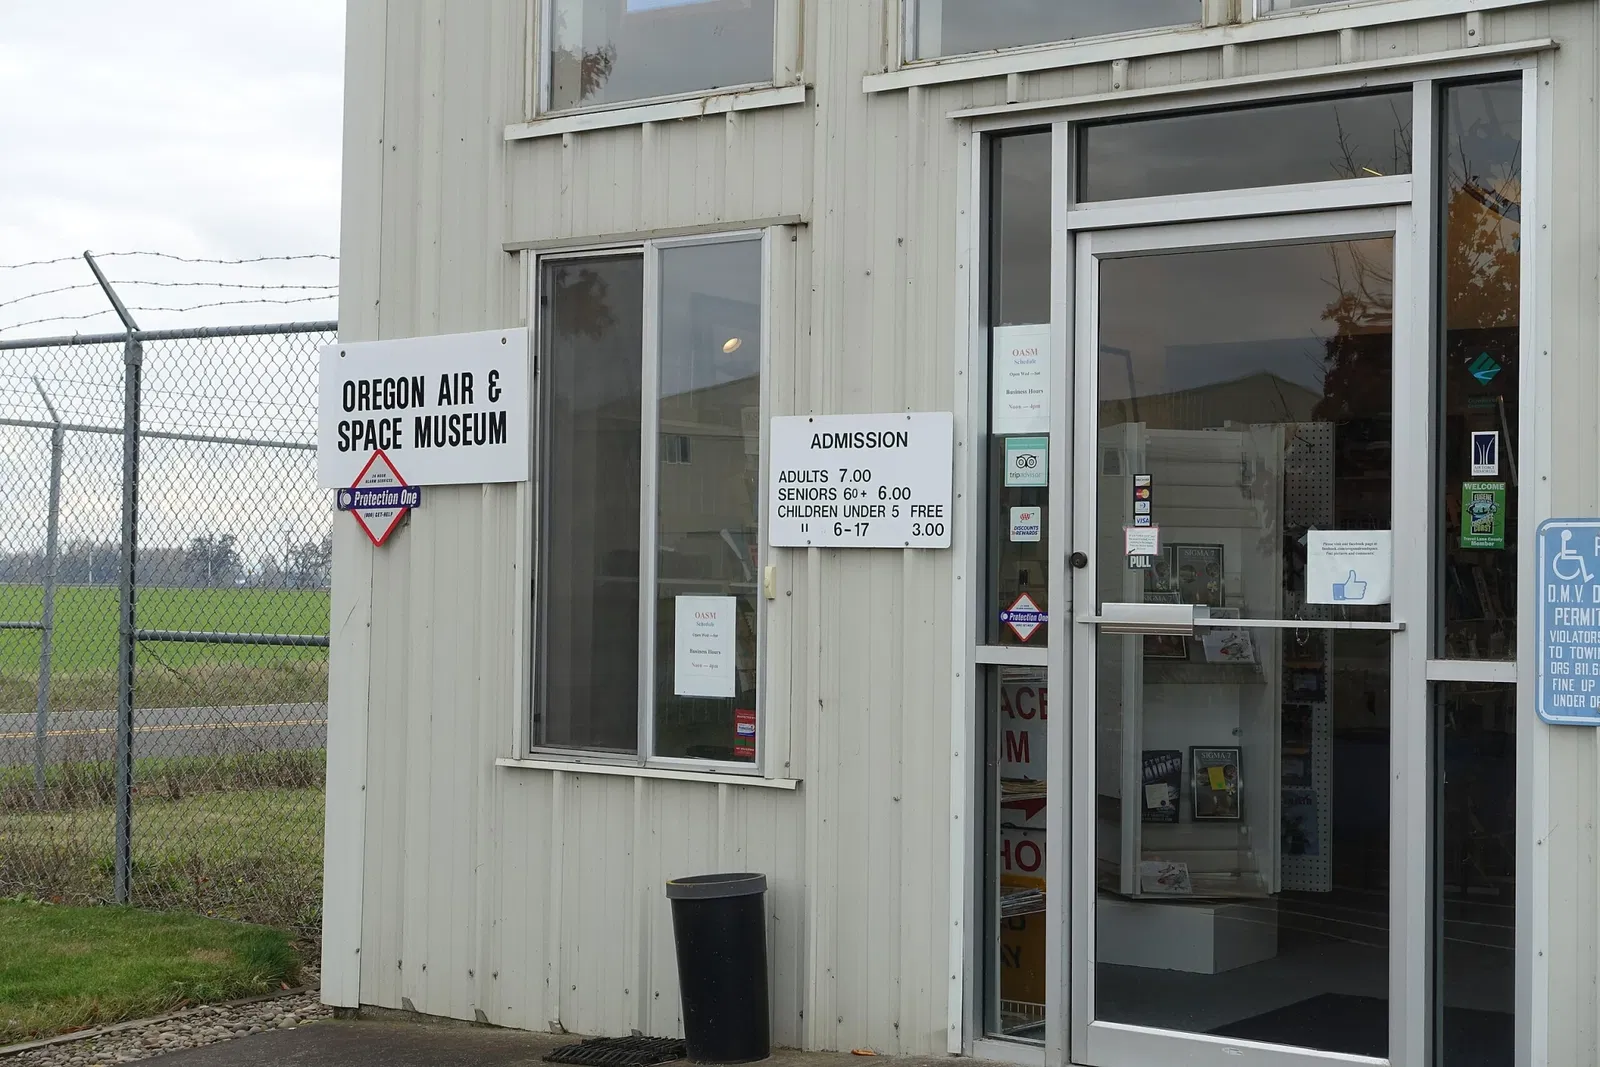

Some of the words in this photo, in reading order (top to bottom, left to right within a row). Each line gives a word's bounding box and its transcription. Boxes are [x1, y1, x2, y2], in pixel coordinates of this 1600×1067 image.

[1012, 348, 1038, 357] OASM
[342, 375, 425, 412] OREGON
[438, 371, 473, 406] AIR
[488, 369, 502, 403] &
[338, 417, 403, 452] SPACE
[414, 410, 507, 448] MUSEUM
[810, 431, 908, 449] ADMISSION
[778, 470, 829, 483] ADULTS
[839, 468, 872, 483] 7.00
[354, 490, 399, 506] Protection
[400, 489, 418, 505] One
[778, 487, 837, 500] SENIORS
[878, 486, 911, 500] 6.00
[777, 504, 838, 518] CHILDREN
[843, 504, 886, 518] UNDER
[891, 504, 900, 518] 5
[910, 504, 943, 518] FREE
[833, 522, 869, 537] 6-17
[912, 522, 945, 536] 3.00
[1130, 555, 1151, 568] PULL
[1548, 584, 1584, 603] D.M.V.
[1009, 613, 1037, 621] Protection
[1549, 646, 1562, 659] TO
[1551, 662, 1569, 675] ORS
[1575, 663, 1600, 676] 811.6
[1552, 678, 1574, 692] FINE
[1581, 679, 1596, 692] UP
[1553, 694, 1585, 708] UNDER
